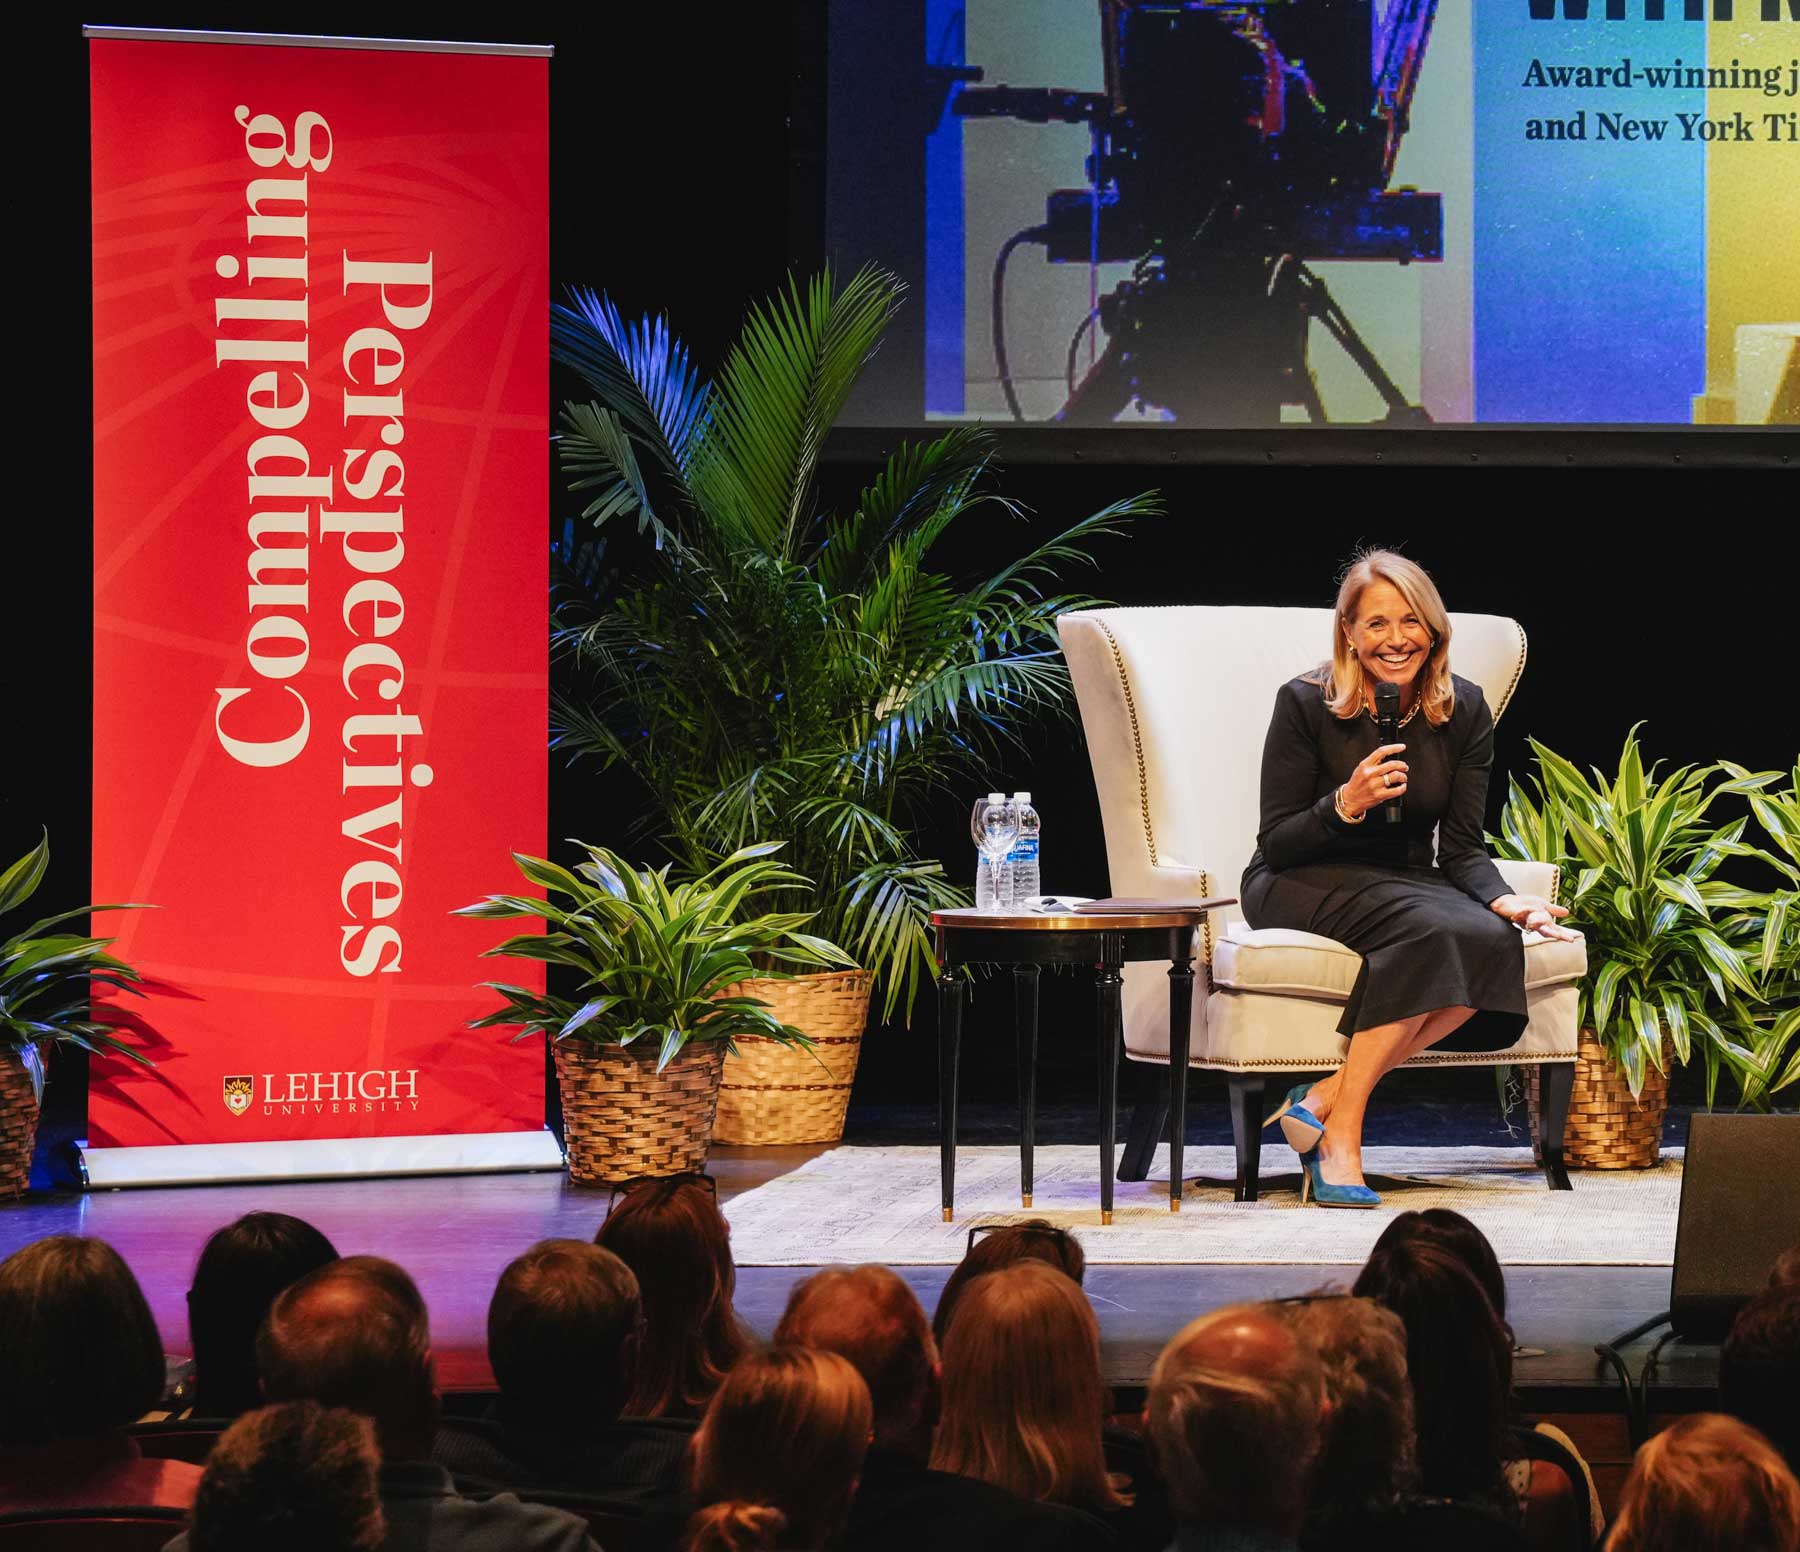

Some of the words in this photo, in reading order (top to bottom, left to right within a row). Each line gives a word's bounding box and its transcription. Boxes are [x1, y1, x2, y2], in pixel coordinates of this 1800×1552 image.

[1522, 59, 1782, 96] Award-winning
[1525, 111, 1587, 142] and
[1596, 112, 1667, 142] New
[1680, 112, 1754, 143] York
[216, 105, 333, 767] Compelling
[320, 249, 433, 977] Perspectives
[262, 1069, 418, 1103] LEHIGH
[264, 1101, 418, 1116] UNIVERSITY
